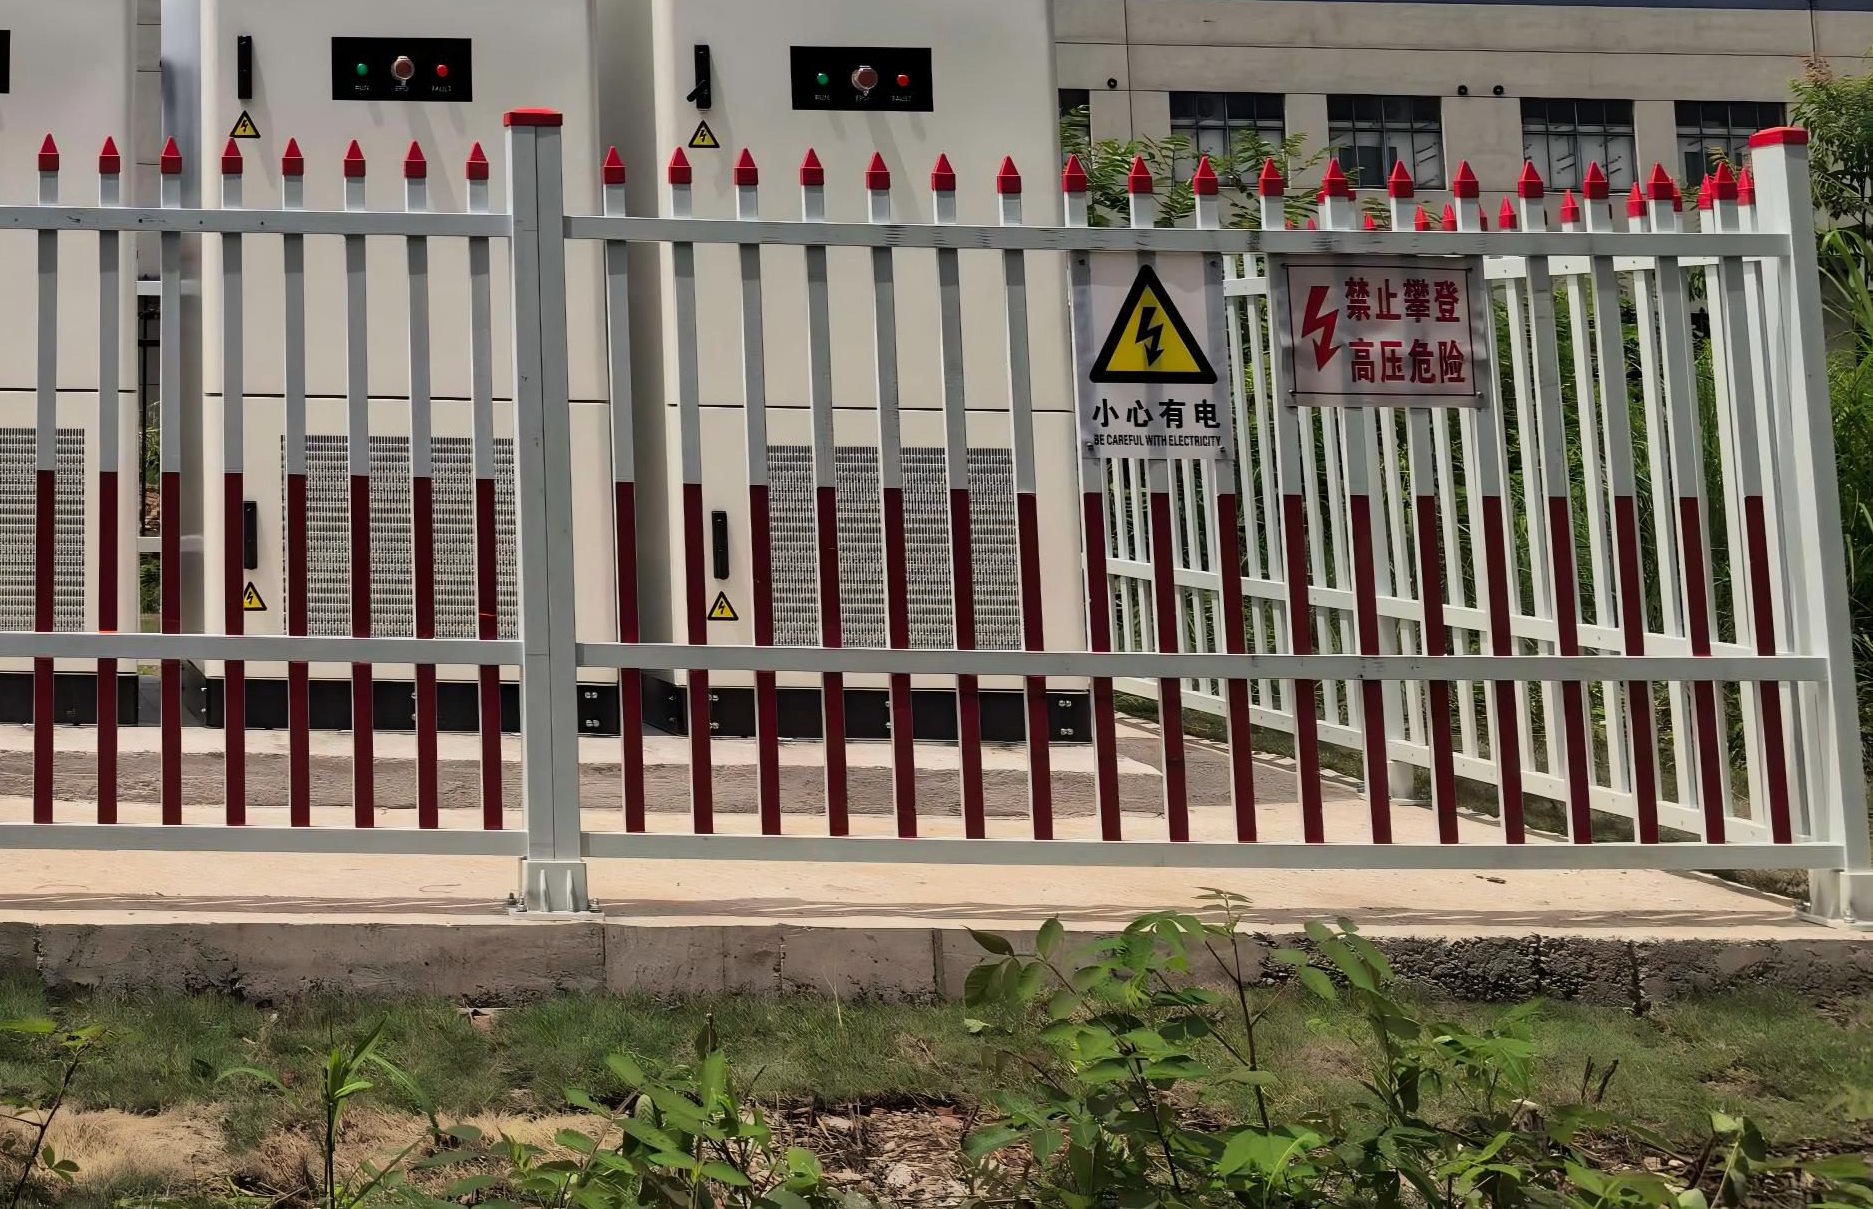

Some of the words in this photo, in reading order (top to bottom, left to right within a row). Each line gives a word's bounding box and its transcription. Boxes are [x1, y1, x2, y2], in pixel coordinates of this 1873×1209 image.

[1345, 277, 1459, 323] 禁止攀登
[1349, 338, 1465, 383] 高压危险
[1092, 398, 1221, 428] 小心有电
[1094, 434, 1105, 446] BE
[1106, 434, 1144, 446] CAREFUL
[1145, 435, 1167, 447] WITH
[1168, 435, 1222, 447] ELECTRICITY
